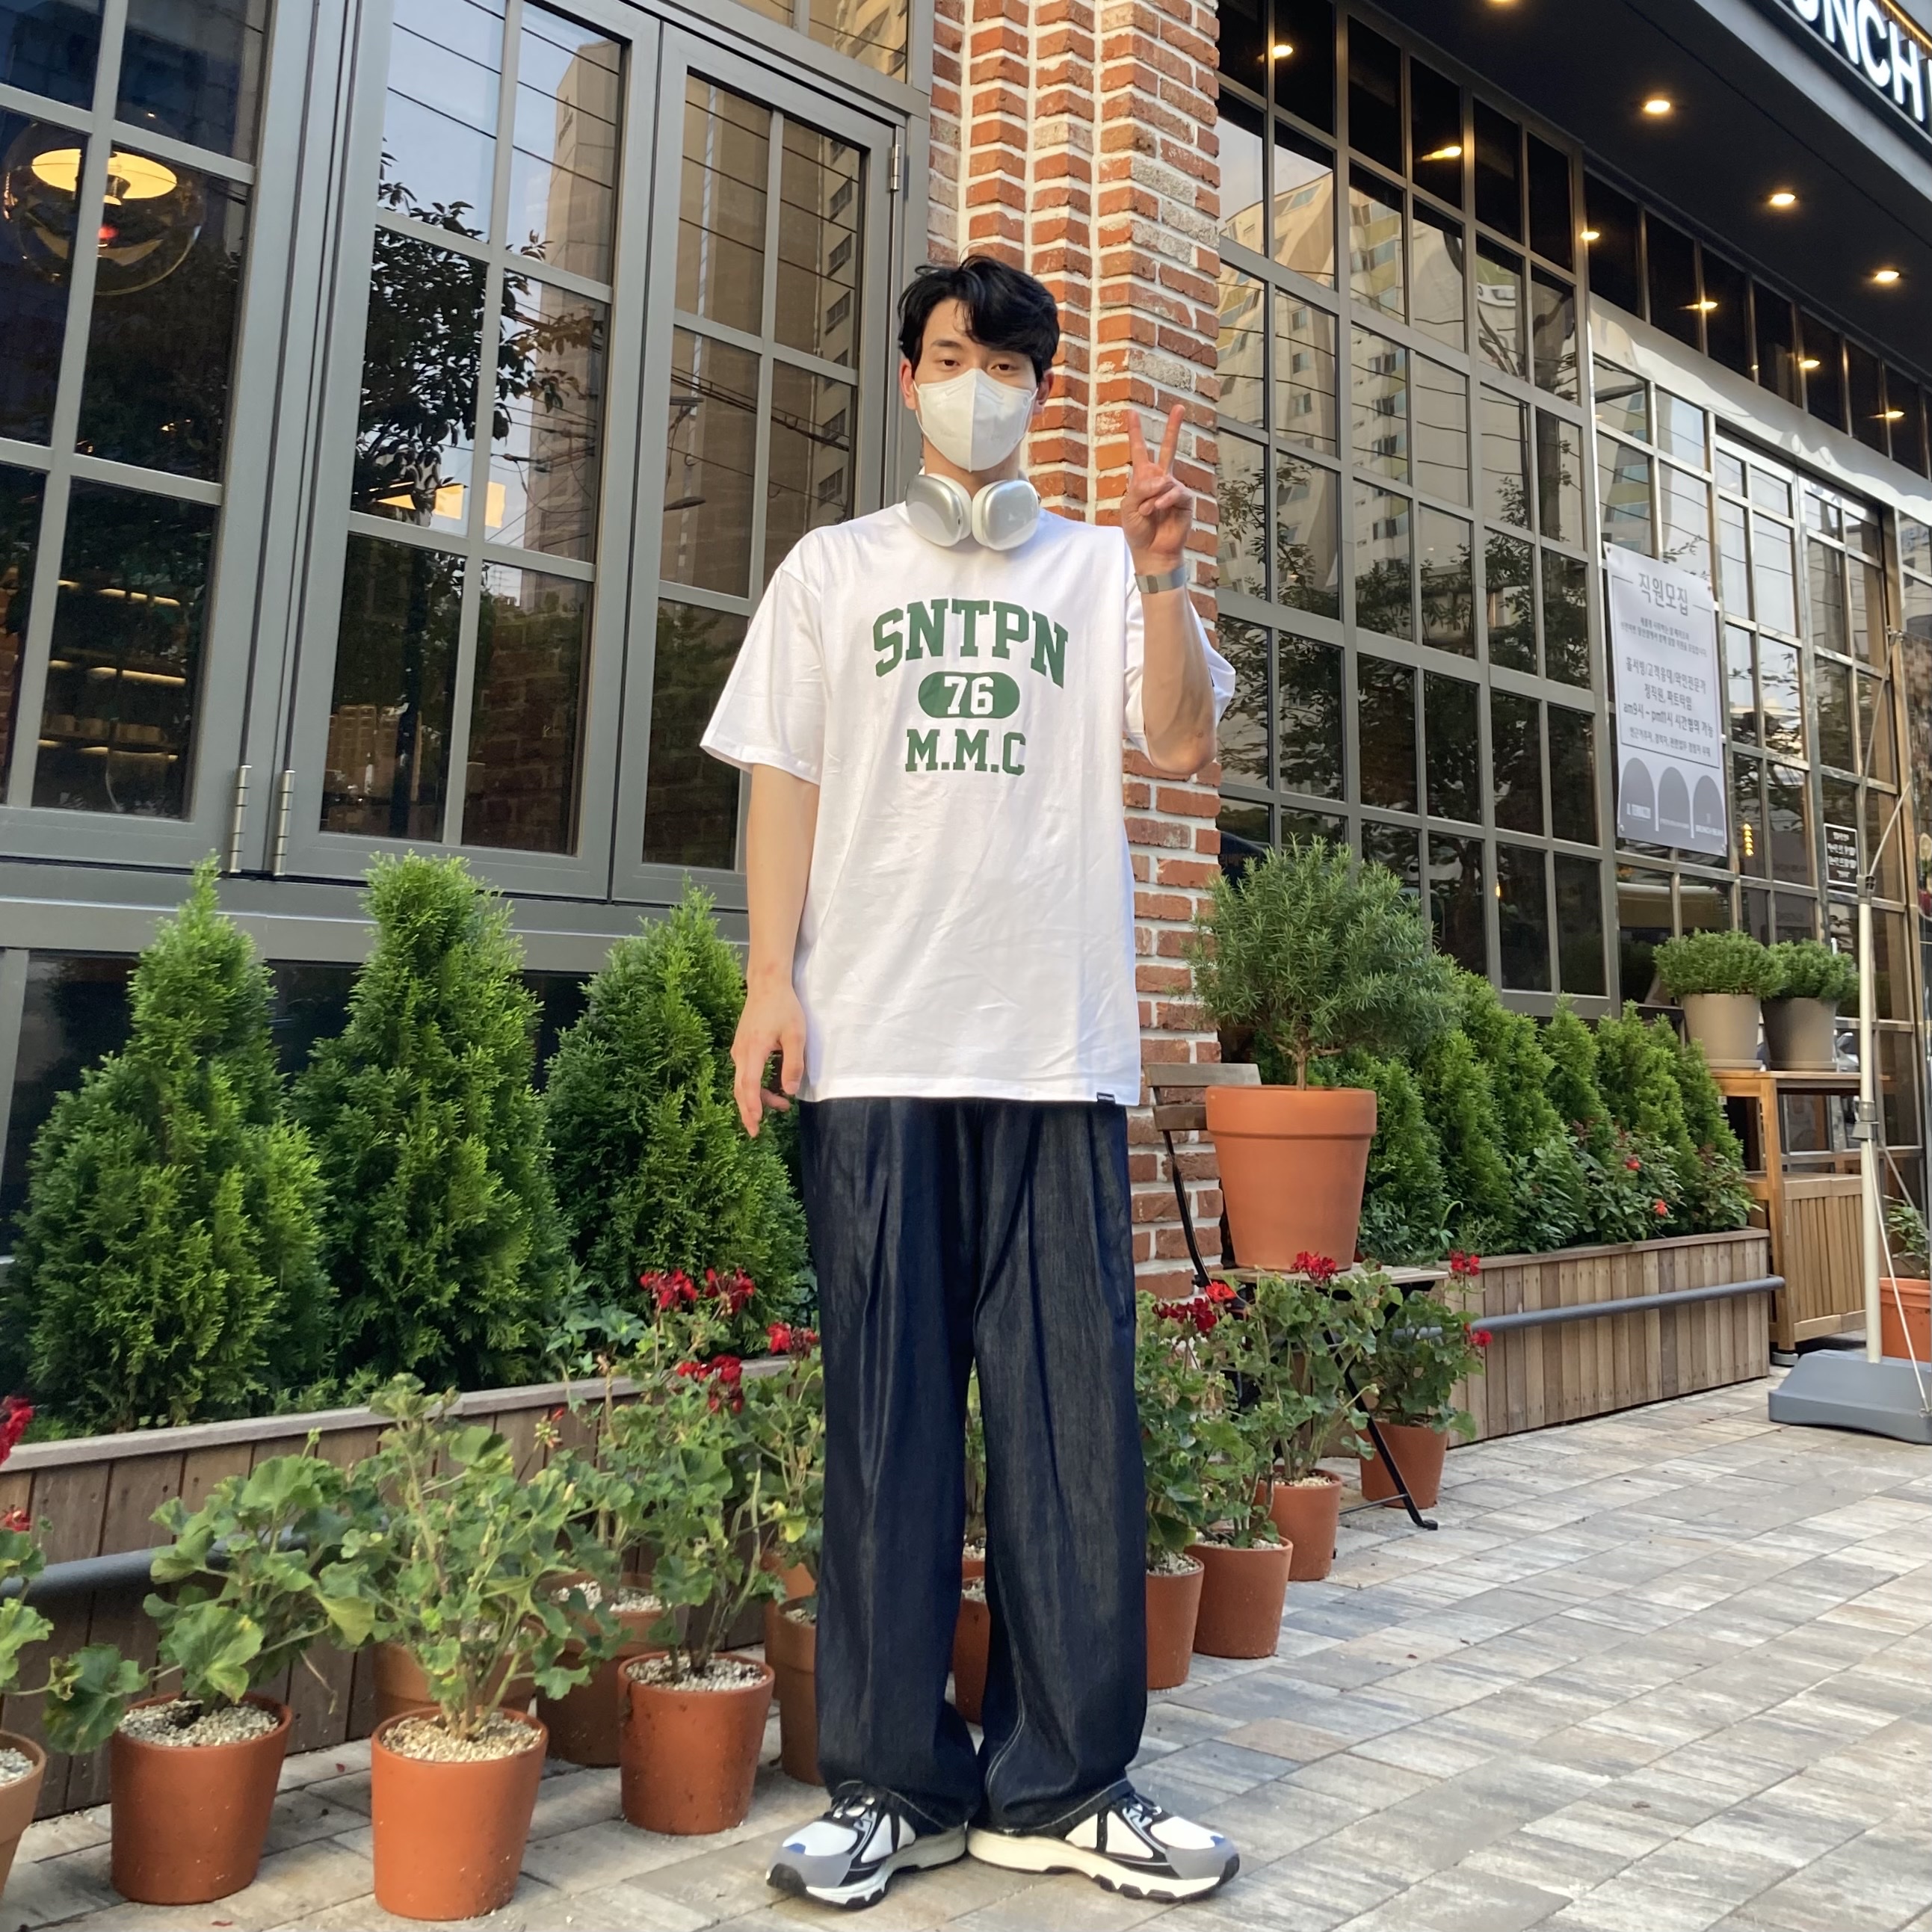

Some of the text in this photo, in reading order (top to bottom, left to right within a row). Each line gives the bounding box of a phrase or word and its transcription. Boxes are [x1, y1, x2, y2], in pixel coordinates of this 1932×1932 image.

[1639, 572, 1688, 616] 직원모집
[873, 598, 1068, 689] SNTPN
[944, 676, 994, 715] 76
[1667, 691, 1692, 711] 파트타임
[905, 729, 1026, 776] M.M.C
